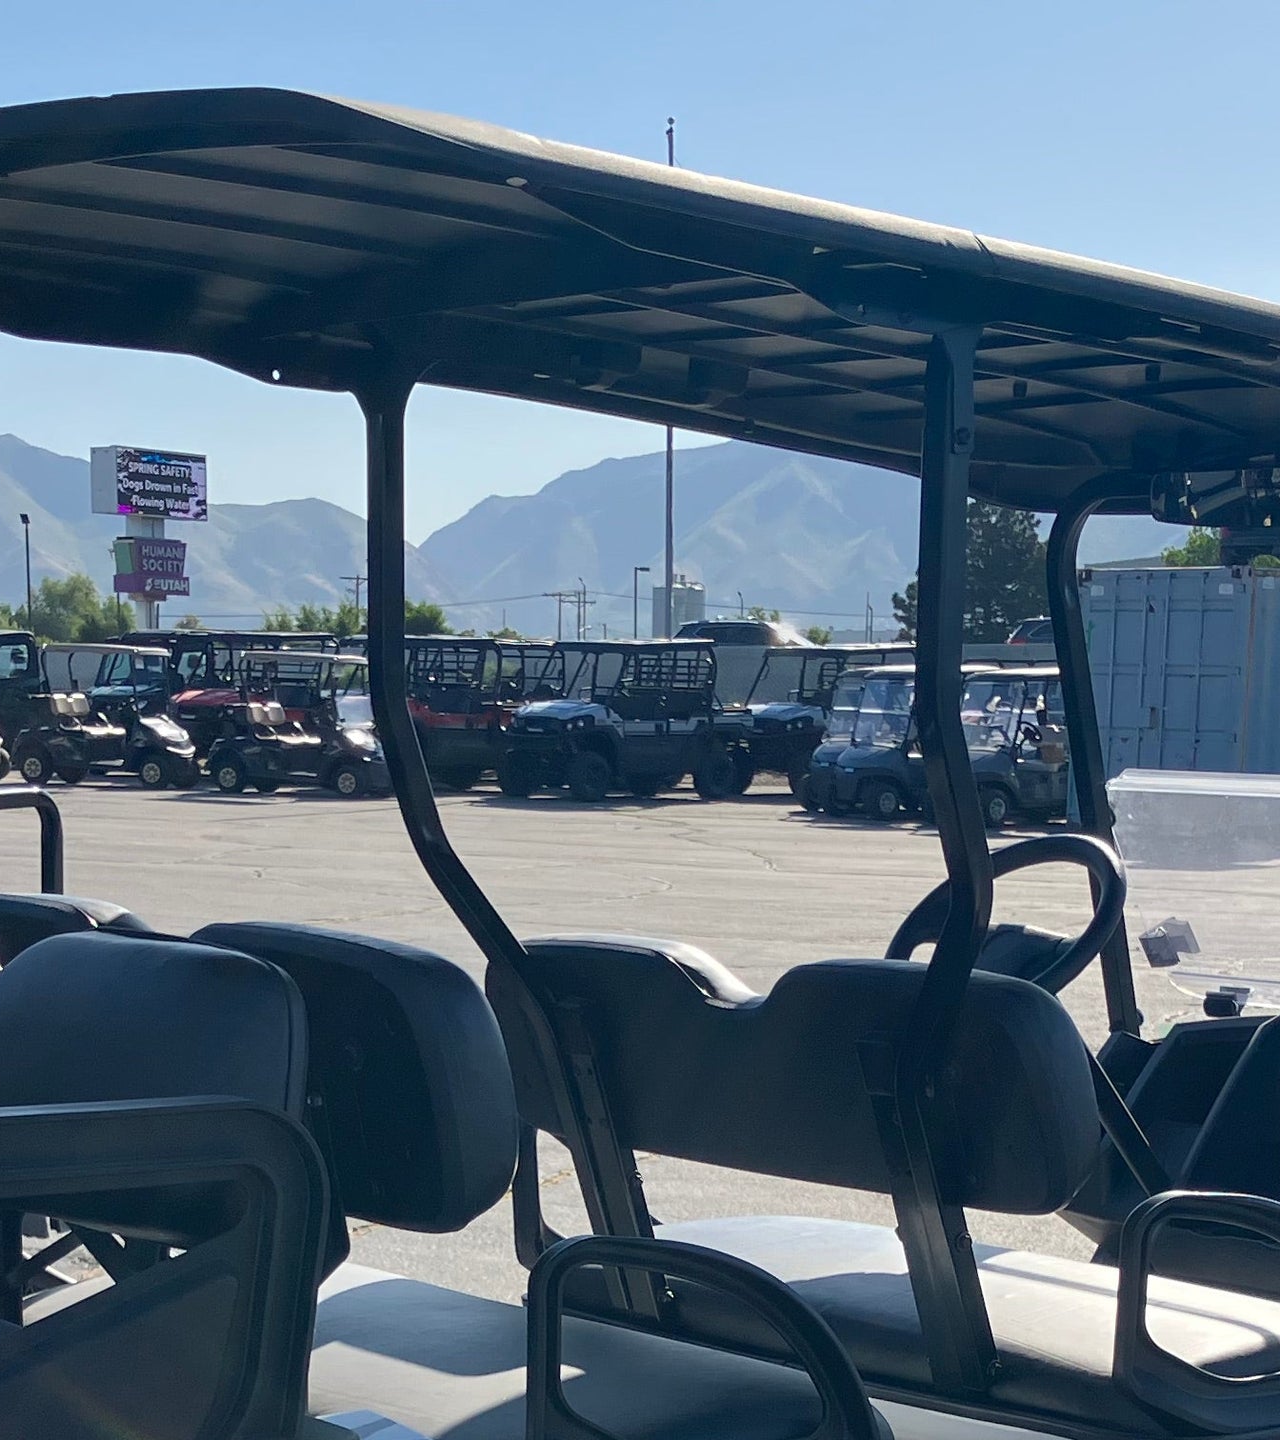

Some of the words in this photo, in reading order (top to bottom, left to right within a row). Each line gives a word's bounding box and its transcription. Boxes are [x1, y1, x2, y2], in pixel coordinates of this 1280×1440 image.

[128, 461, 160, 475] SPRING
[123, 478, 143, 492] Dogs
[145, 480, 172, 493] Drown
[173, 482, 181, 494] in
[166, 498, 189, 510] Water
[142, 545, 184, 559] HUMANE
[142, 559, 184, 573] SOCIETY
[161, 579, 188, 592] UTAH
